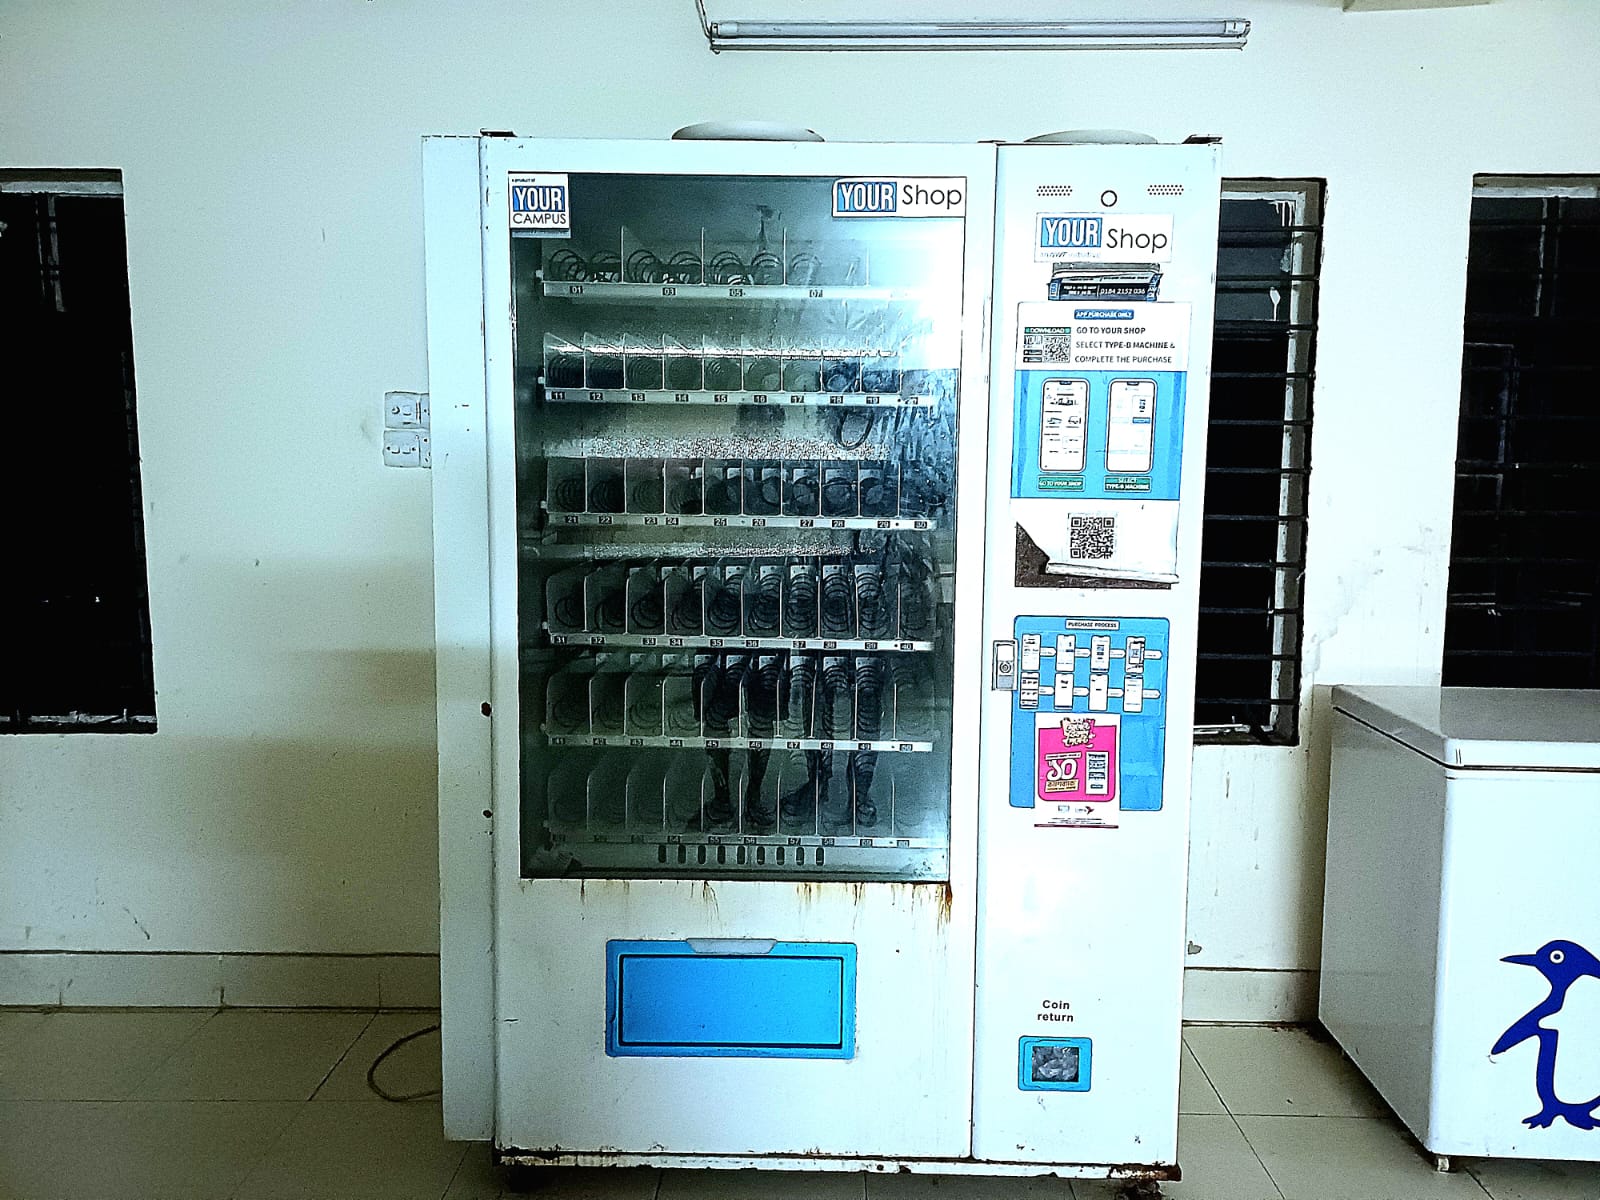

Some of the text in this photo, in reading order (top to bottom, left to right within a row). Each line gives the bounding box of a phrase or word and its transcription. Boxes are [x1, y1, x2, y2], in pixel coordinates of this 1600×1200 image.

[515, 187, 563, 211] YOUR
[842, 183, 962, 211] YOUR Shop
[512, 213, 566, 224] CAMPUS
[1045, 219, 1167, 253] YOUR Shop
[571, 286, 582, 294] 01
[1123, 327, 1146, 335] SHOP
[1075, 355, 1114, 363] COMPLETE
[600, 516, 611, 524] 22
[711, 639, 722, 647] 35
[902, 642, 913, 650] 40
[1042, 1000, 1070, 1009] Coin
[1037, 1013, 1074, 1022] return
